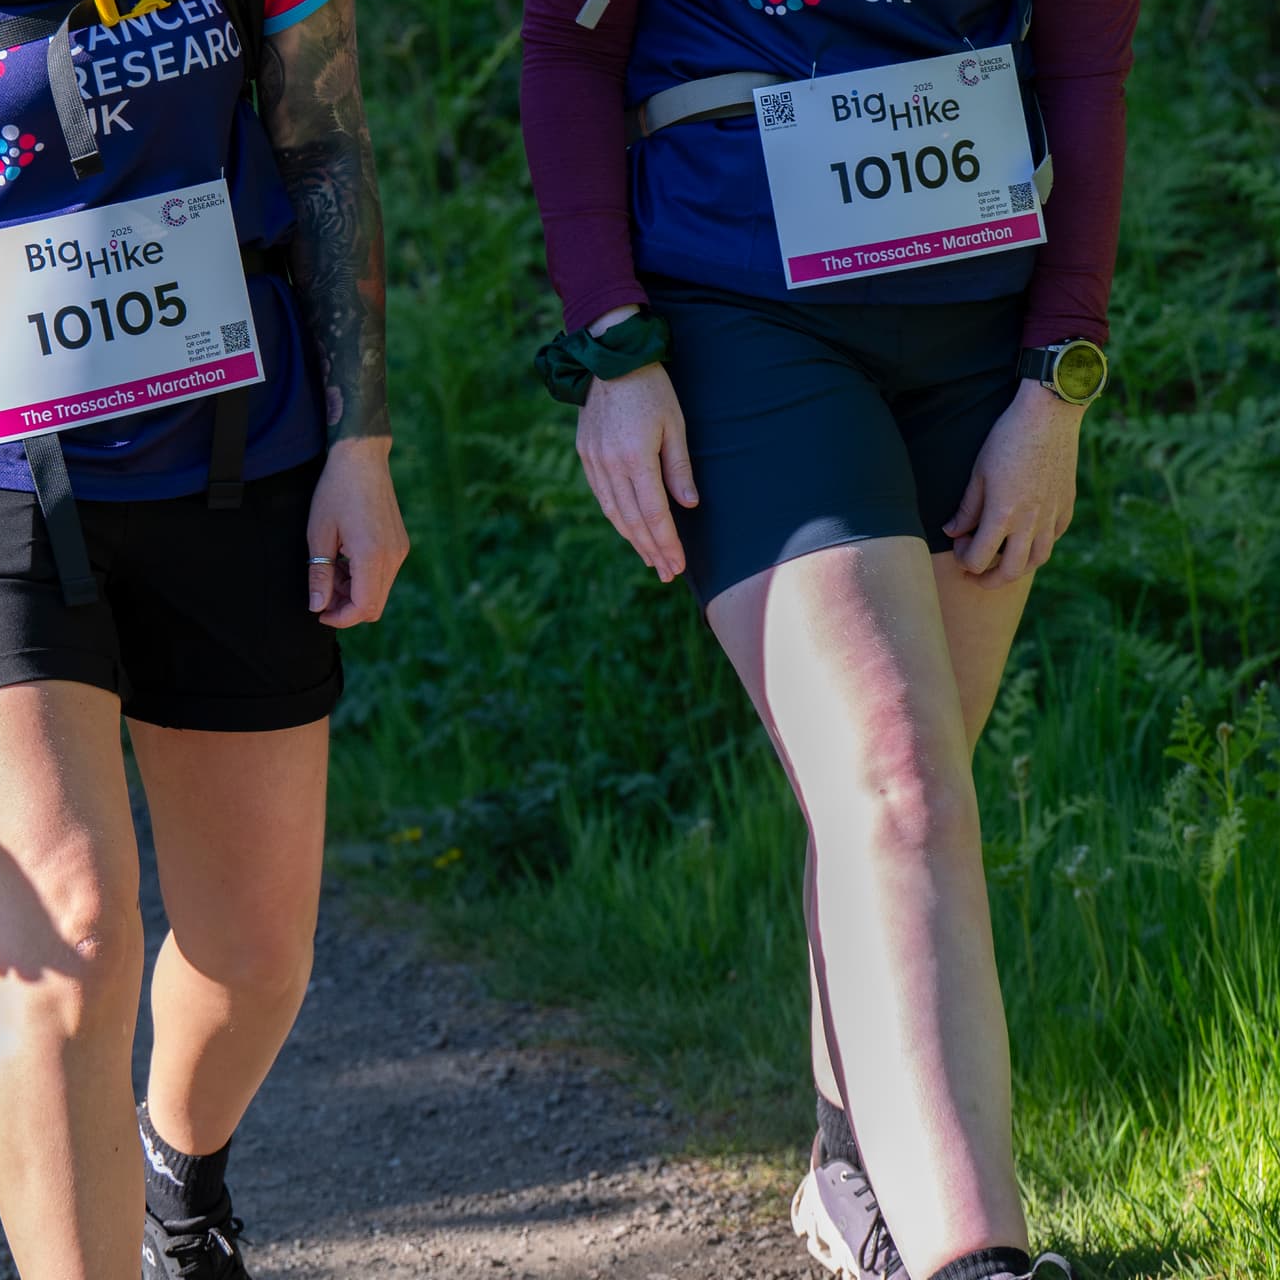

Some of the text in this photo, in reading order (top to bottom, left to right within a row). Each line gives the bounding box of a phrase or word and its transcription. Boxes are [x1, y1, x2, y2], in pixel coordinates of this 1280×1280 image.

[75, 20, 242, 101] RESEARC
[913, 82, 933, 93] 2025
[830, 139, 981, 204] 10106
[187, 193, 216, 205] CANCER
[189, 199, 225, 211] RESEARCH
[110, 226, 133, 238] 2025
[821, 254, 852, 271] The
[854, 241, 931, 266] Trossachs
[942, 225, 1013, 251] Marathon
[27, 281, 187, 356] 10105
[21, 408, 53, 426] The
[54, 390, 136, 419] Trossachs
[146, 367, 226, 398] Marathon
